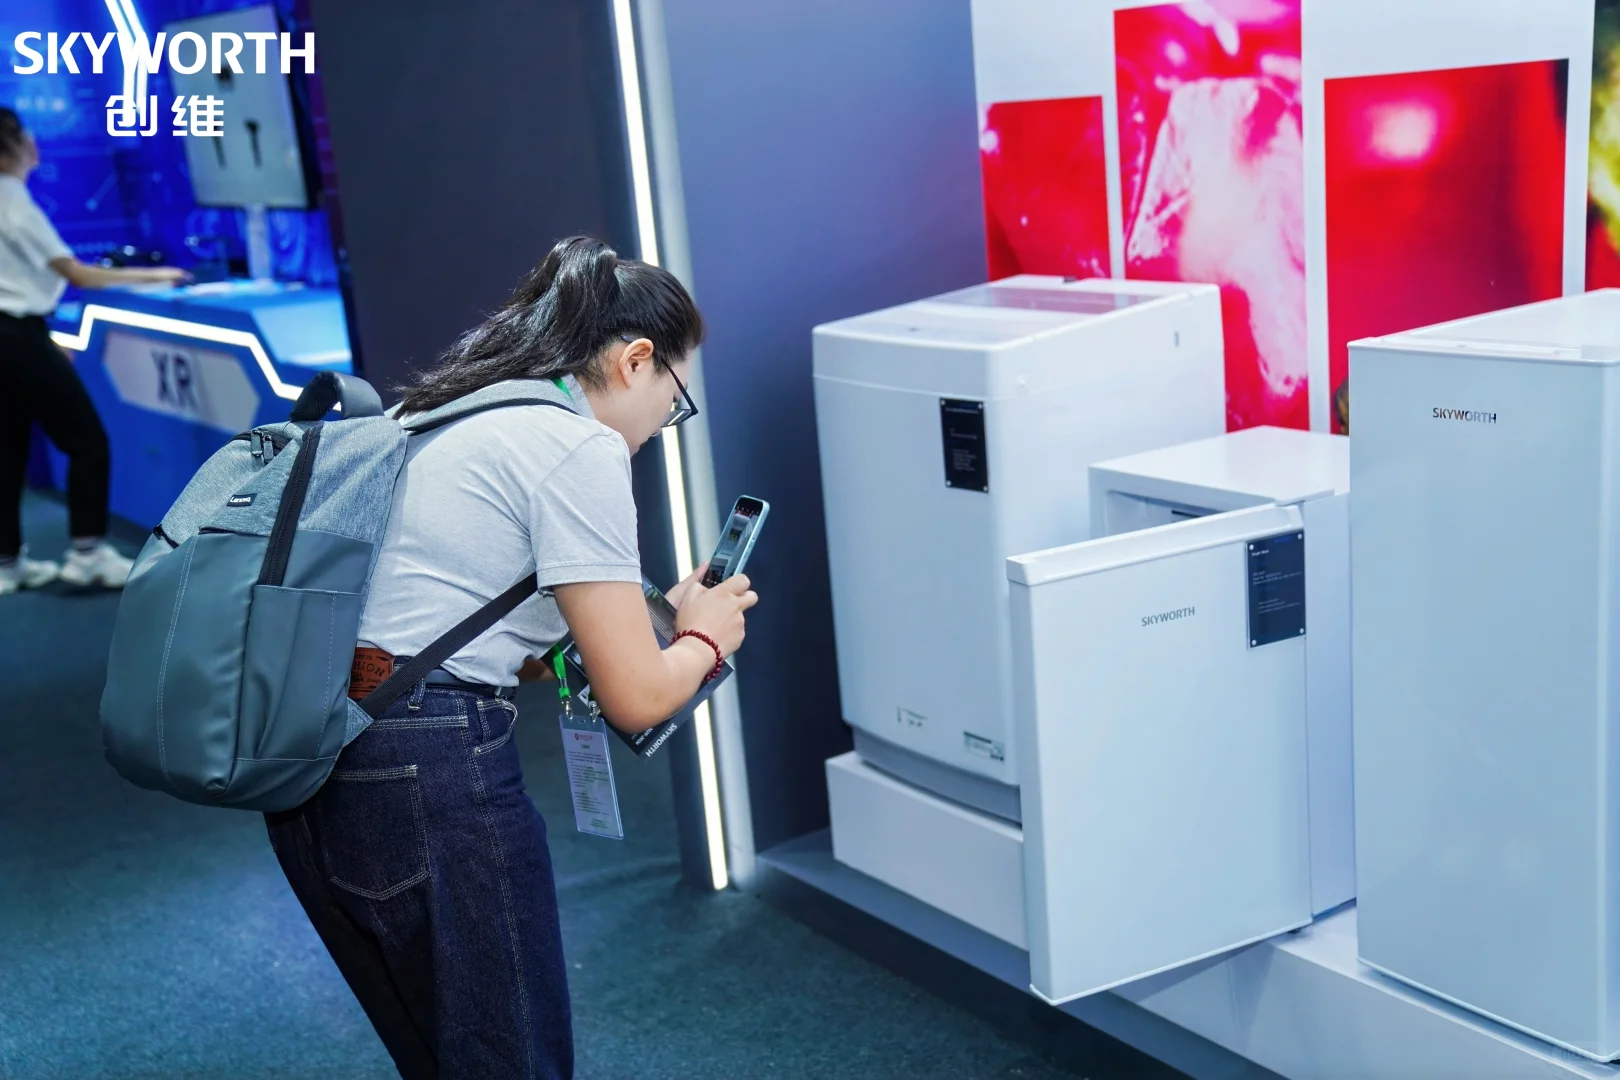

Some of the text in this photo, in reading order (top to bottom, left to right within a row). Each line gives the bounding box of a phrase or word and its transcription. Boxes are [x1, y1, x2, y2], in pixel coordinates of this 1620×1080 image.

[152, 352, 199, 408] XR
[1432, 407, 1497, 424] SKYWORTH
[1141, 606, 1195, 627] SKYWORTH
[645, 722, 677, 757] SKYWORTH
